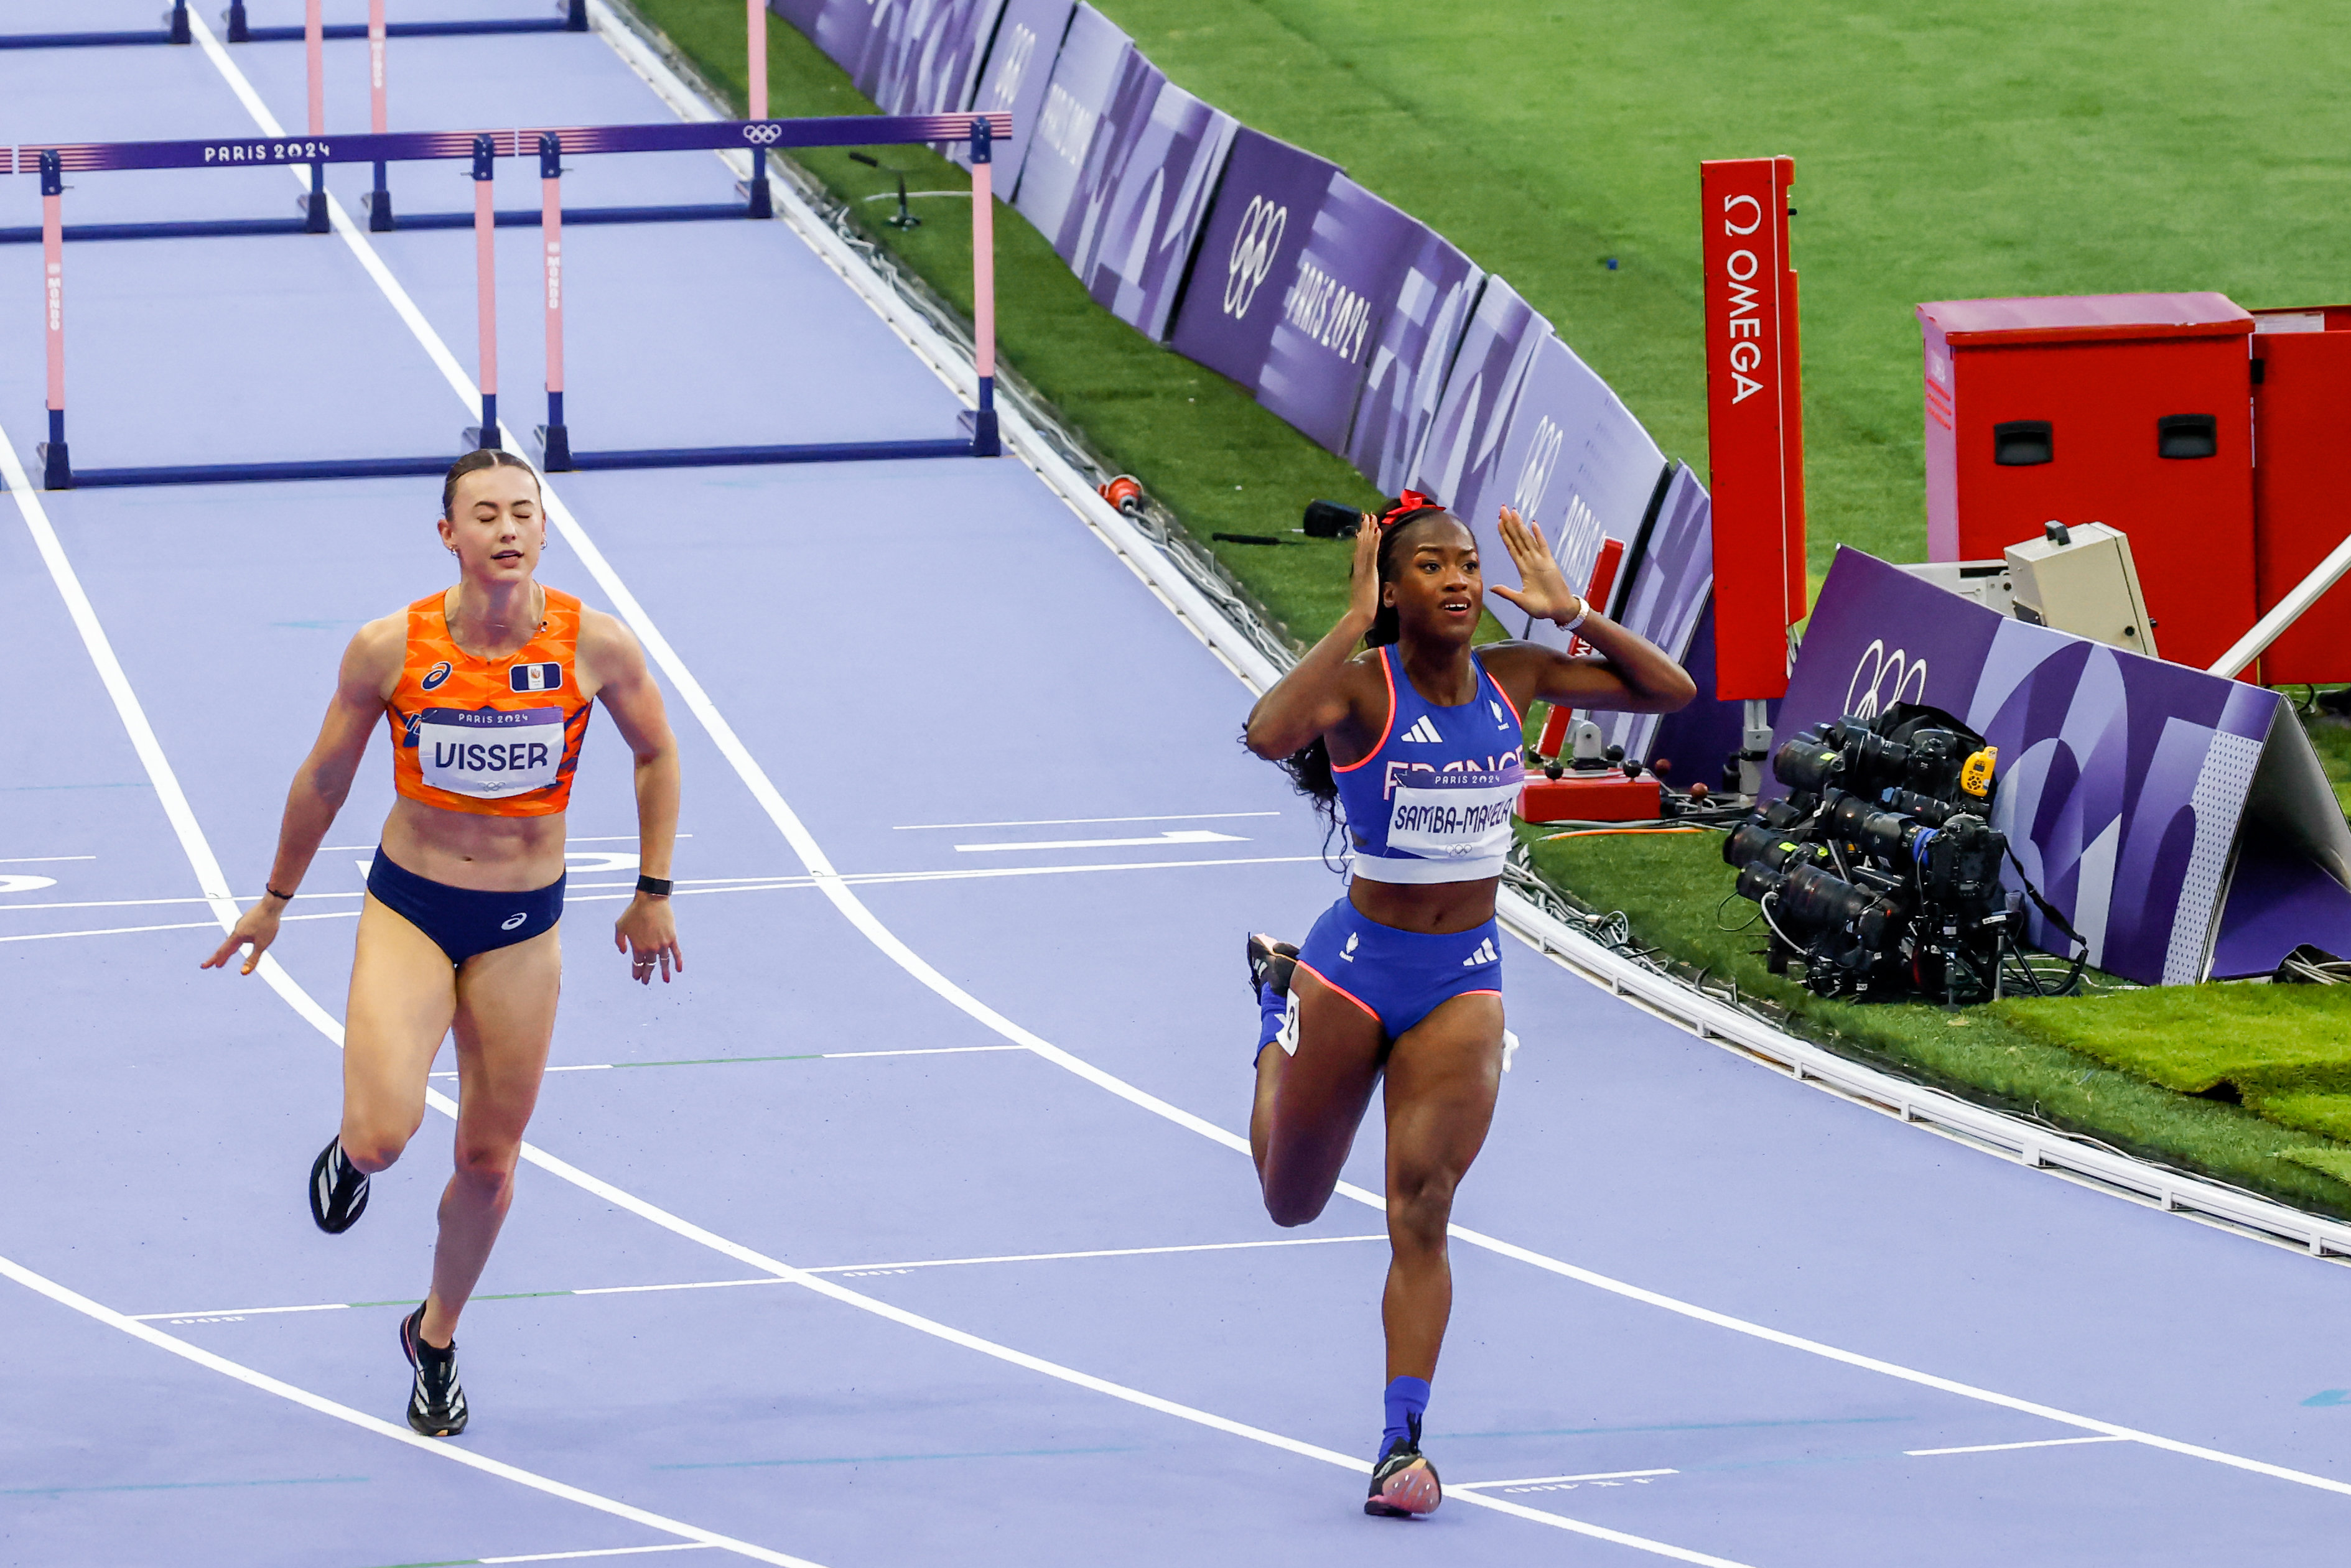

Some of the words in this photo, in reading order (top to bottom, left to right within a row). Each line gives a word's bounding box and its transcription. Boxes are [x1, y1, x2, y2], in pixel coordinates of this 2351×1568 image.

[205, 145, 266, 162] PARIS
[274, 142, 330, 159] 2024
[1286, 261, 1336, 339] PARIS
[1320, 285, 1371, 364] 2024
[1726, 249, 1764, 404] OMEGA
[457, 713, 493, 723] PARIS
[497, 714, 528, 723] 2024
[435, 741, 548, 771] VISSER
[1435, 776, 1468, 784] PARIS
[1472, 774, 1501, 784] 2024
[1287, 1005, 1295, 1041] 2
